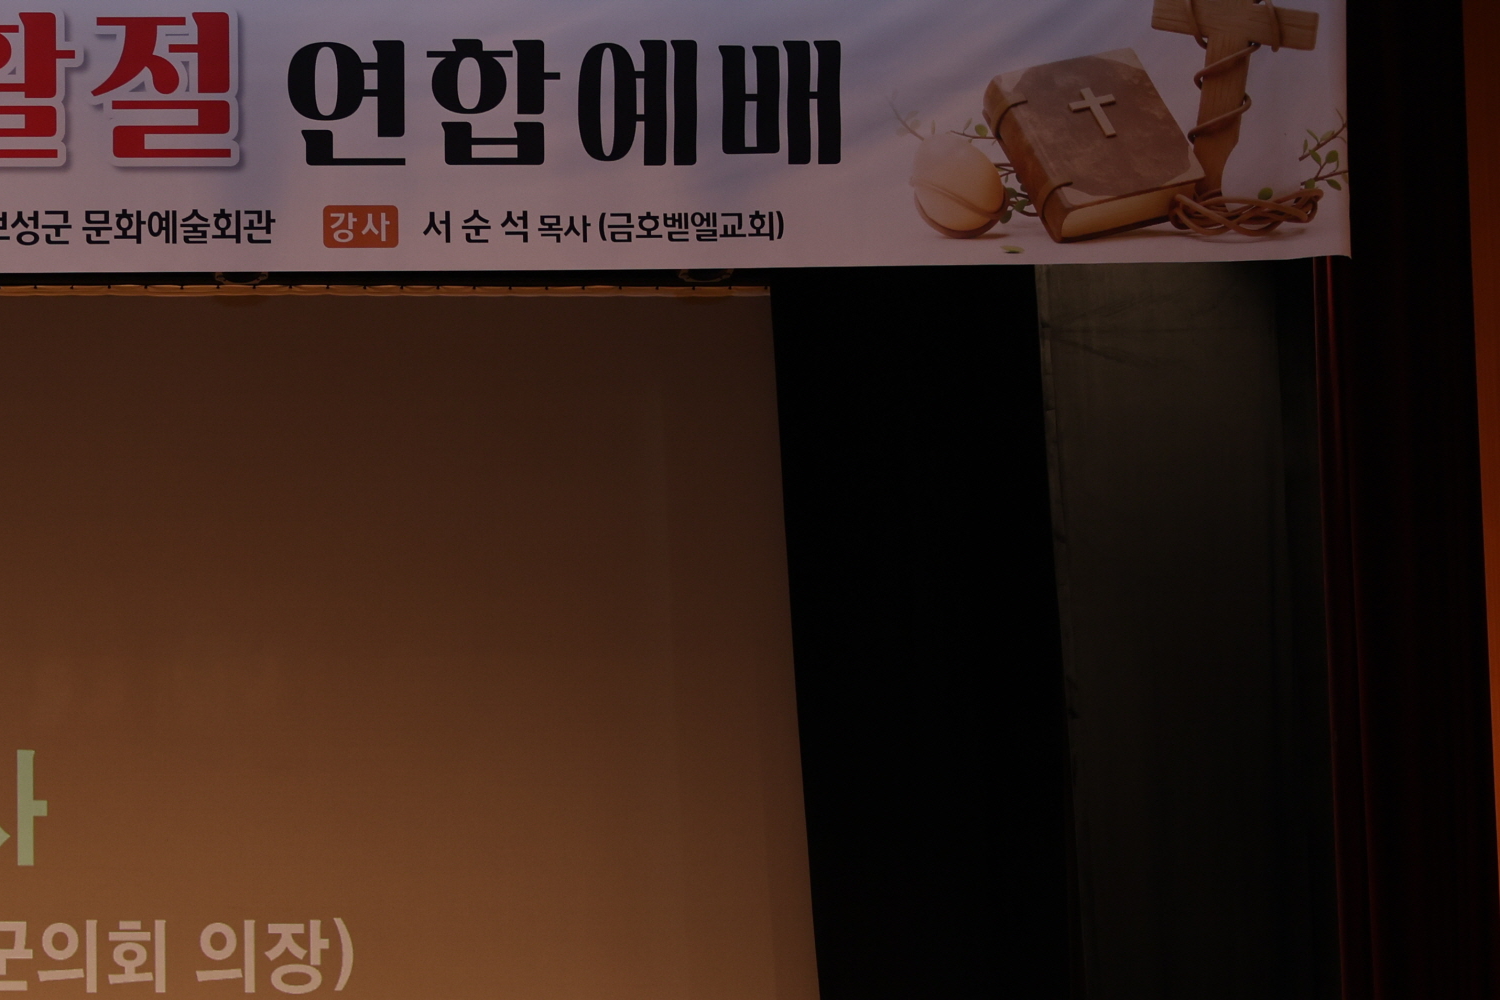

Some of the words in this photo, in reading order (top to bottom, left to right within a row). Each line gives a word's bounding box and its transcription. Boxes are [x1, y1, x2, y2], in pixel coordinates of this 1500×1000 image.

[287, 38, 843, 167] 연합예배
[81, 208, 277, 245] 문화예술회관
[329, 211, 391, 244] 강사
[537, 214, 592, 244] 목사
[598, 209, 785, 243] (금호벧엘교회)
[195, 917, 354, 995] 의장)
